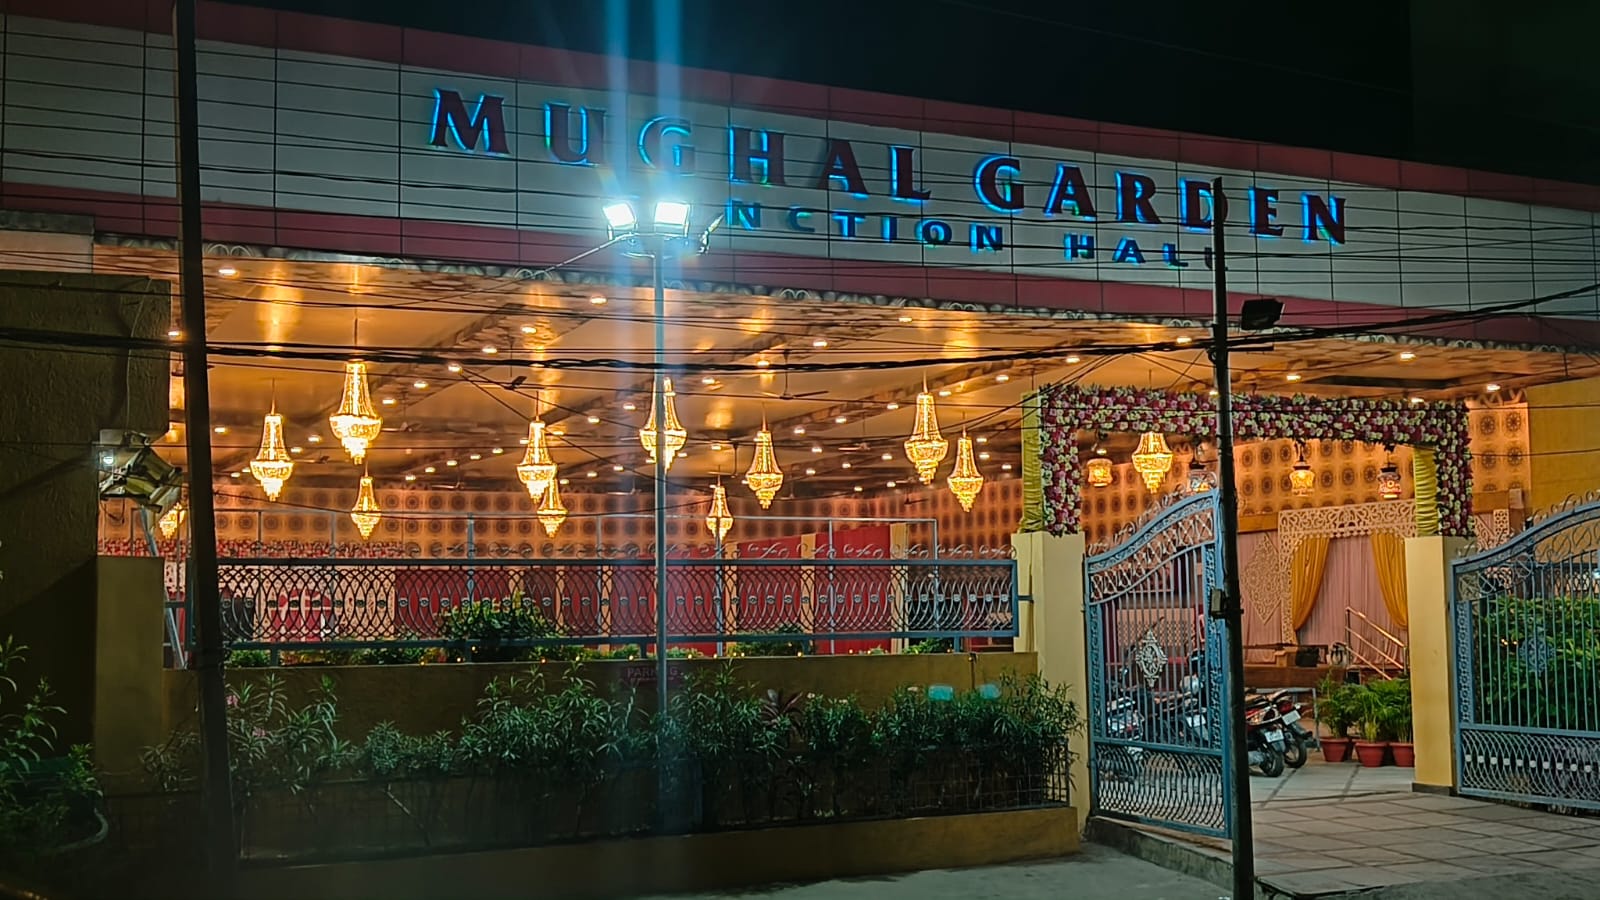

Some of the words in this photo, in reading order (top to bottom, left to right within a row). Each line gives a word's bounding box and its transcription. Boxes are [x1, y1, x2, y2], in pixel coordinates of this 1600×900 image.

[430, 88, 932, 201] MUGHAL
[974, 154, 1346, 245] GARDEN
[726, 199, 1003, 254] NCTION
